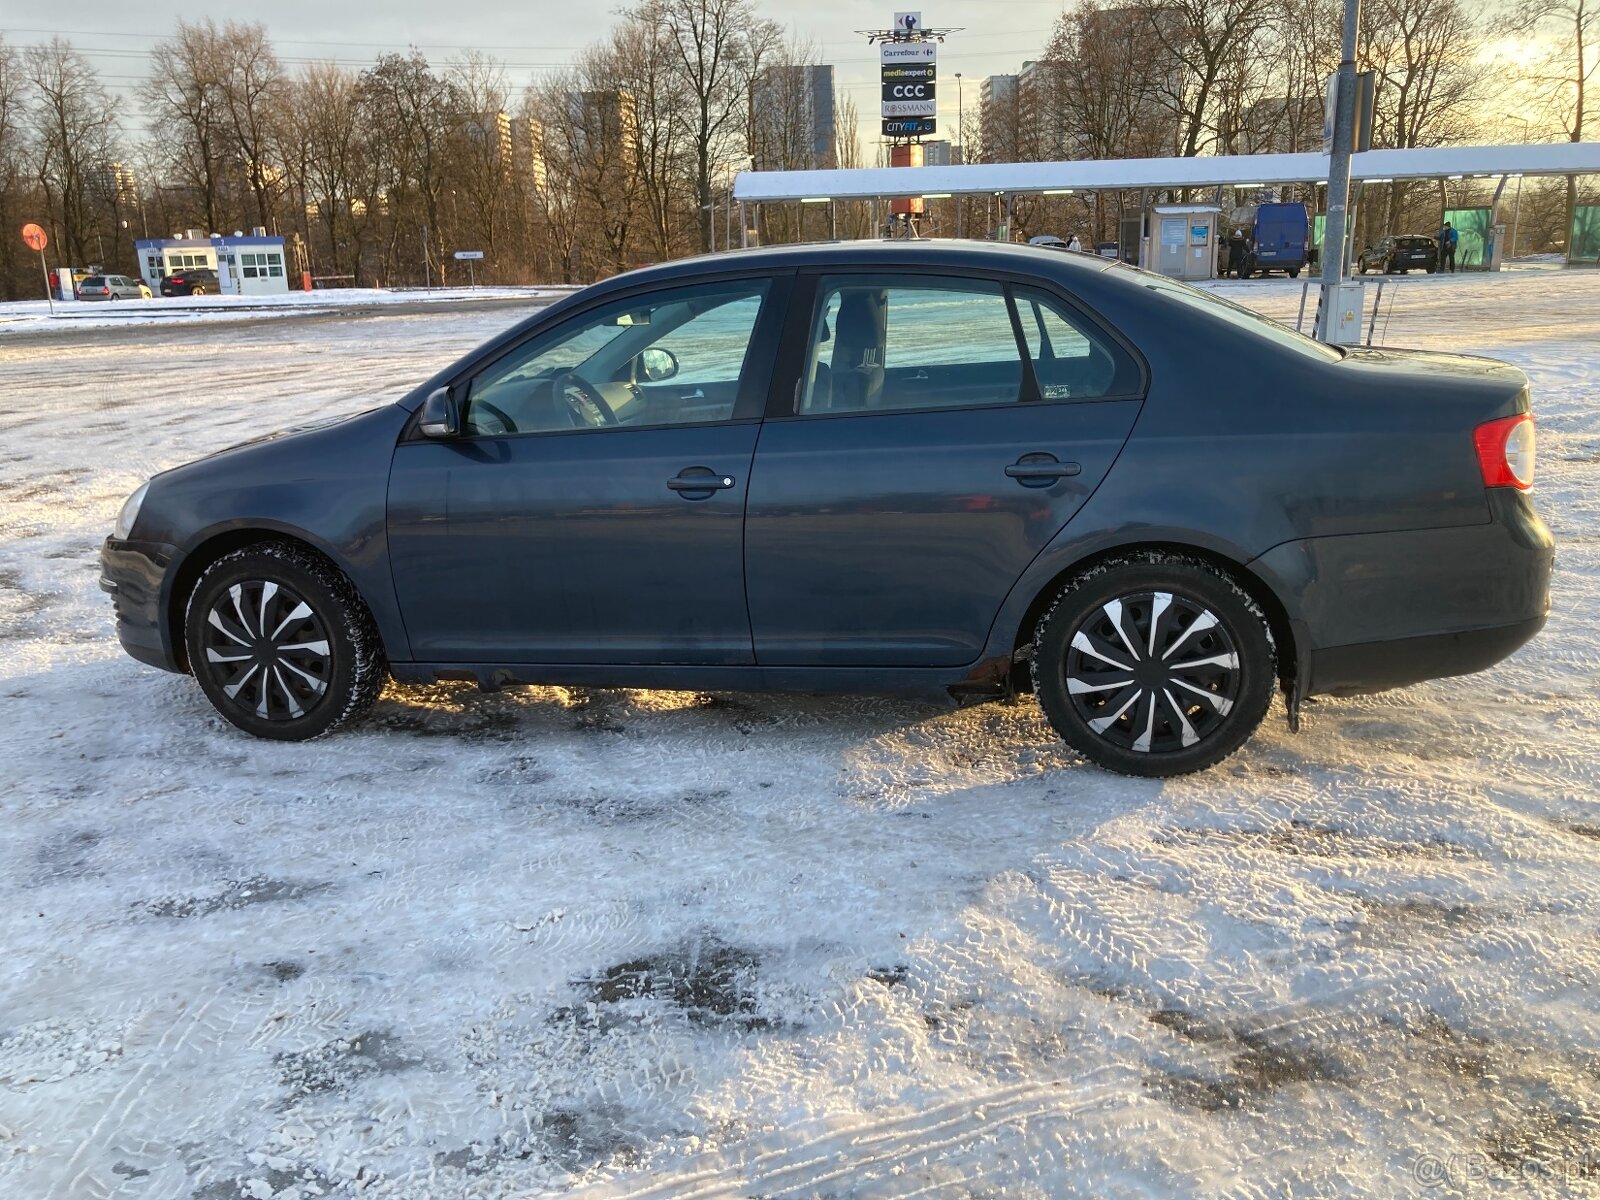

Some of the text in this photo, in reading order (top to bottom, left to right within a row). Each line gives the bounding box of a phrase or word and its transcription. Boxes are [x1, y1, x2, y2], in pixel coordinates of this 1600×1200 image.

[883, 49, 920, 57] Carrefour
[883, 69, 926, 77] mediaexpert
[893, 85, 925, 98] CCC
[884, 104, 933, 112] ROSSMANN
